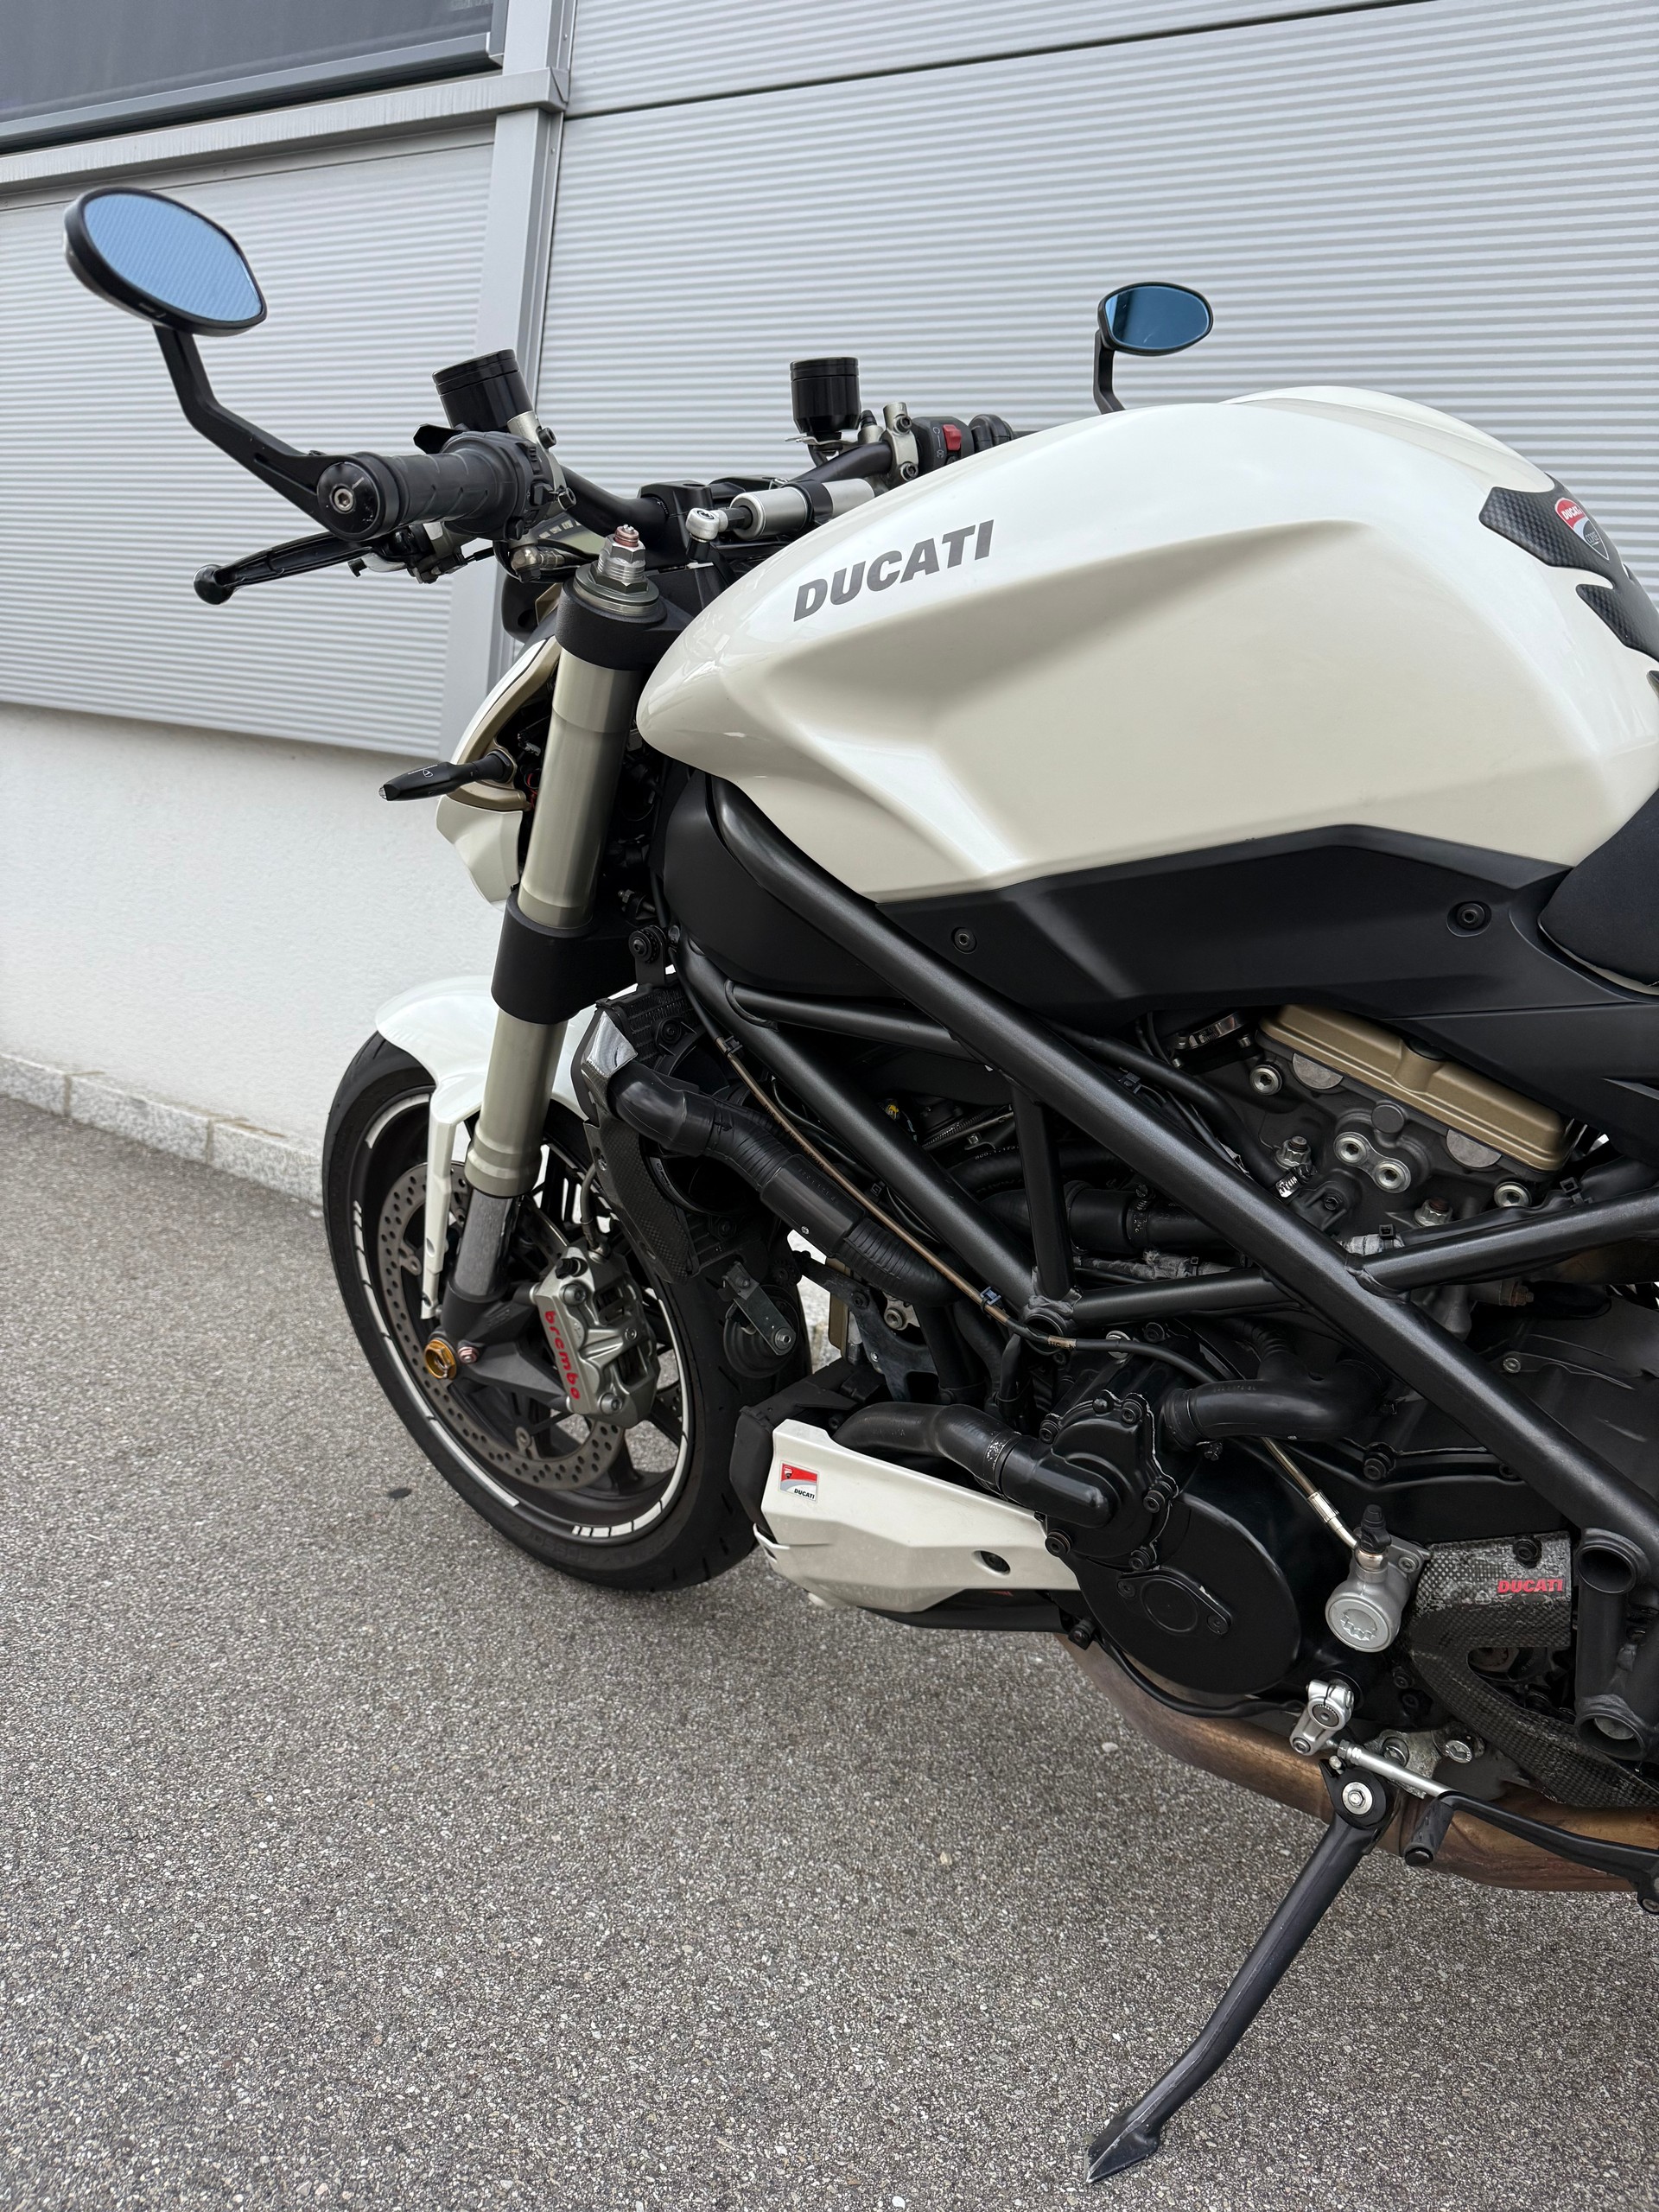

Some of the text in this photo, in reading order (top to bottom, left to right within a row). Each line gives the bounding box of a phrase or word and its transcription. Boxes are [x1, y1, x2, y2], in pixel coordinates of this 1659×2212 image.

[793, 519, 995, 622] DUCATI
[544, 1311, 581, 1400] brembo
[794, 1488, 816, 1499] DUCATI
[1497, 1579, 1563, 1593] DUCATI
